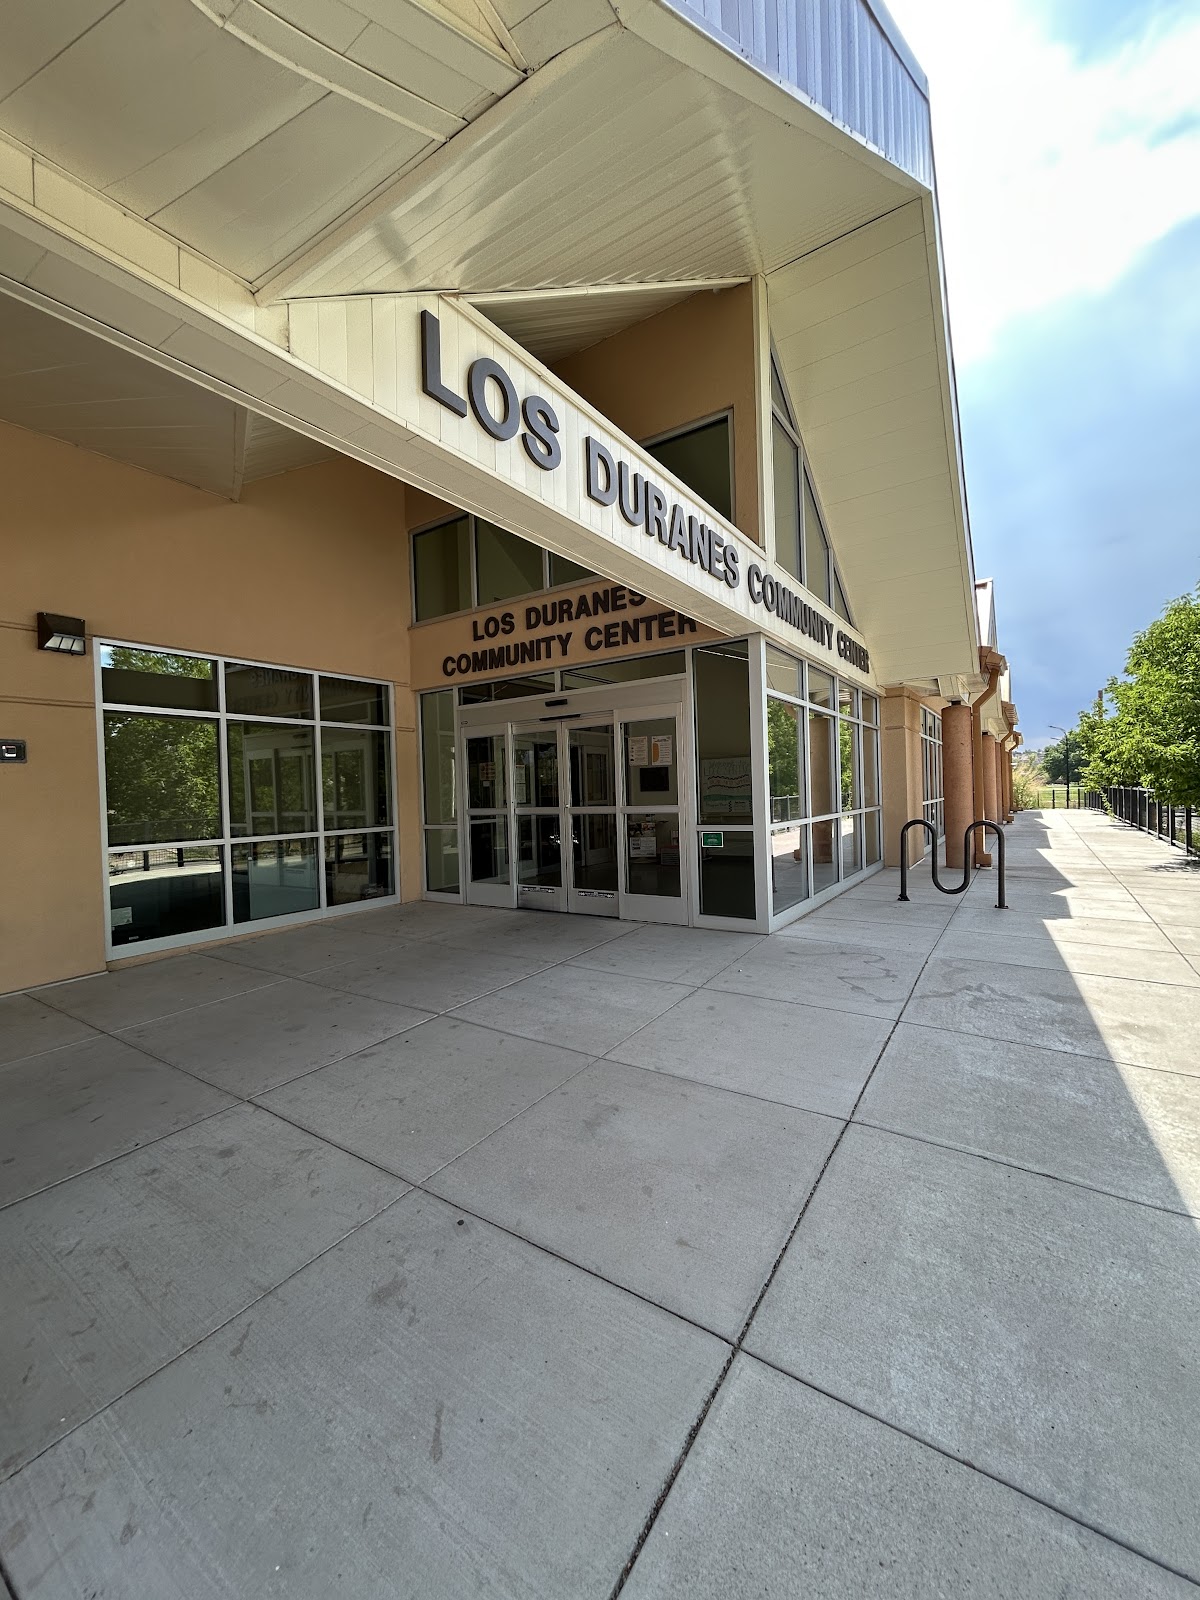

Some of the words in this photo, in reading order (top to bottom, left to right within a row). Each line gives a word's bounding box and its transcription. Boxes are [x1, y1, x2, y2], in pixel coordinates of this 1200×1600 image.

[420, 309, 562, 472] LOS
[585, 435, 740, 589] DURANES
[747, 563, 835, 651] COMMUNITY
[836, 630, 870, 674] CENTER
[442, 631, 573, 677] COMMUNITY
[584, 610, 697, 652] CENTER
[472, 612, 516, 642] LOS
[525, 585, 647, 630] DURANES
